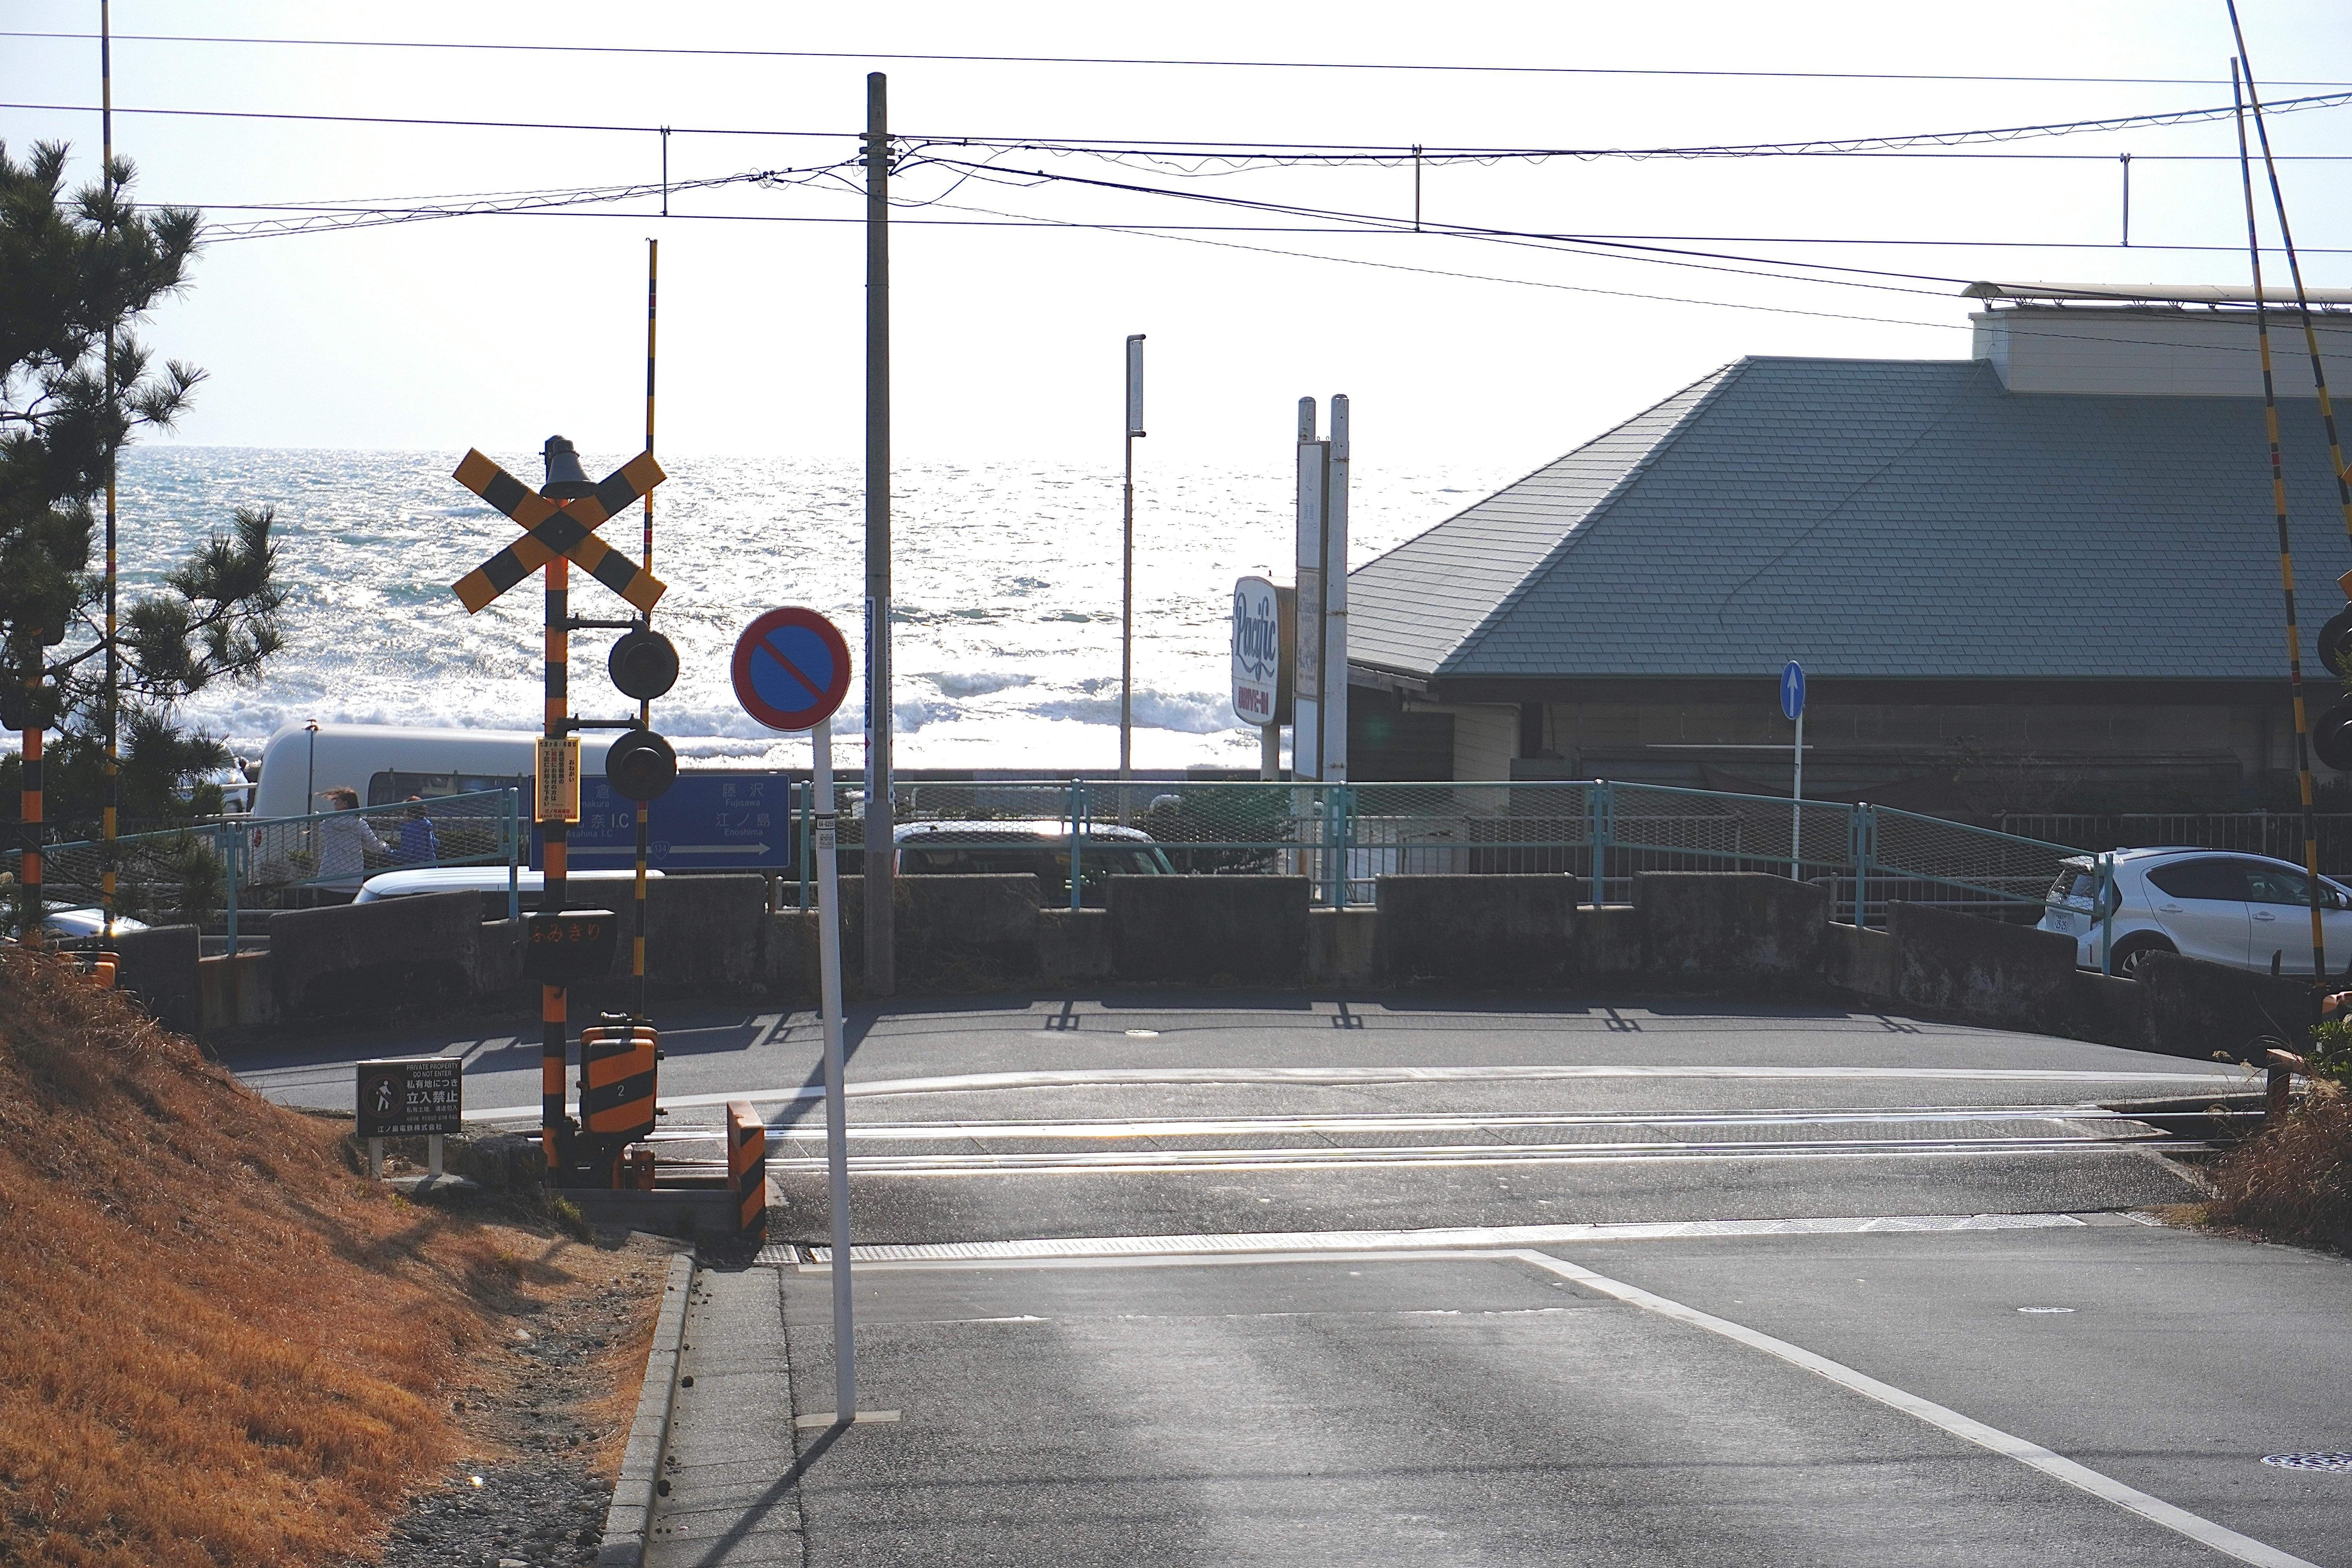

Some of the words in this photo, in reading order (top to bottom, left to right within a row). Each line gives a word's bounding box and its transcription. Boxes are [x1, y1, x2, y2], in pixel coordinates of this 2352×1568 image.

[1236, 592, 1276, 681] Pacific
[1238, 686, 1268, 715] DRIVE-IN
[722, 783, 764, 797] 藤沢
[726, 799, 760, 808] Fujisawa
[716, 813, 770, 827] 江ノ島
[566, 829, 597, 838] Asahina
[529, 923, 600, 943] ふみきり
[407, 1078, 458, 1088] 私有地につき
[406, 1090, 458, 1104] 立入禁止
[617, 1085, 624, 1096] 2
[377, 1123, 442, 1132] 江ノ島電鉄株式会社
